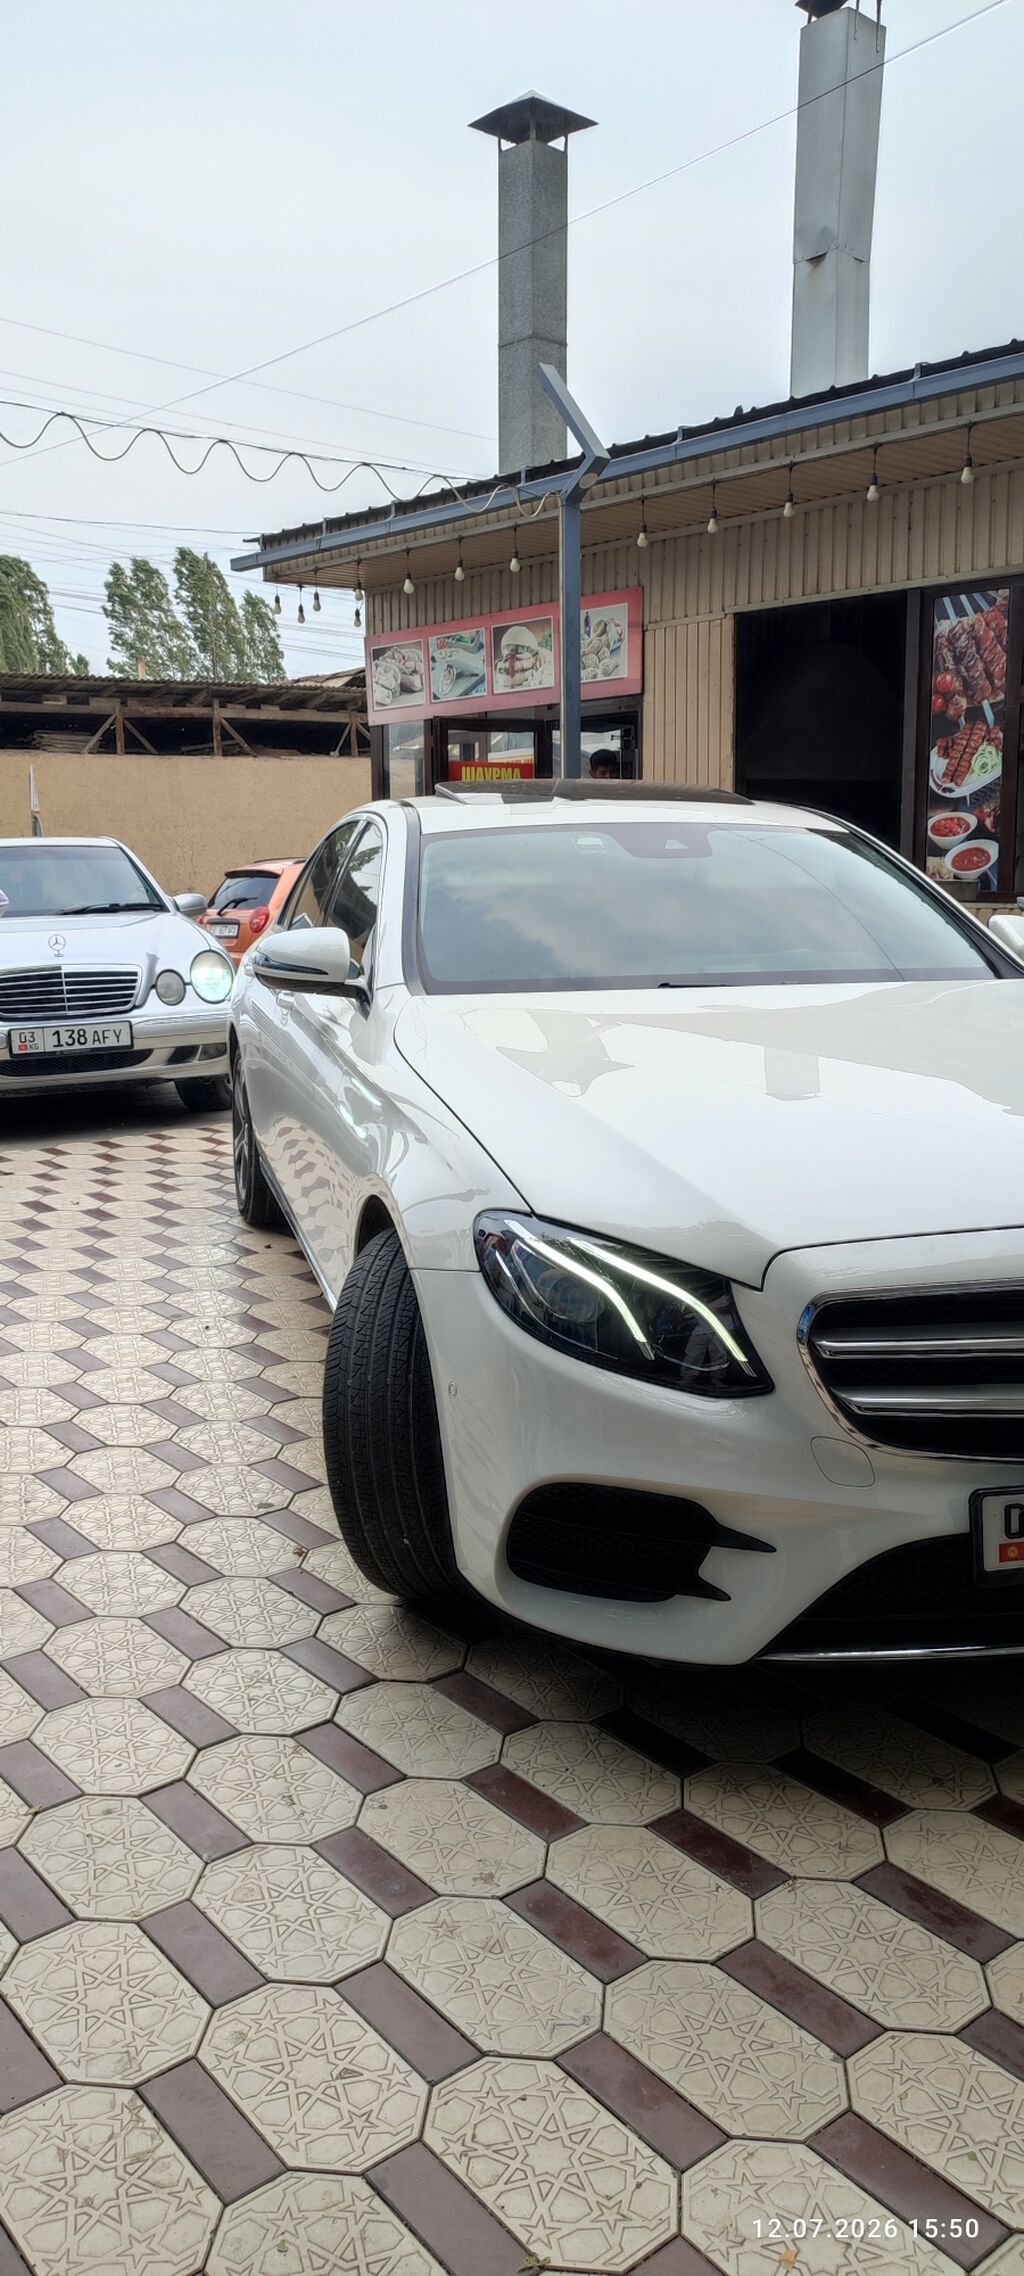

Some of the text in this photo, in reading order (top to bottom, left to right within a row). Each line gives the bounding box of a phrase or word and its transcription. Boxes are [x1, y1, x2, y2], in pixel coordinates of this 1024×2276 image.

[461, 766, 521, 782] ШАУРМА
[18, 1031, 36, 1044] 03
[52, 1028, 88, 1048] 138
